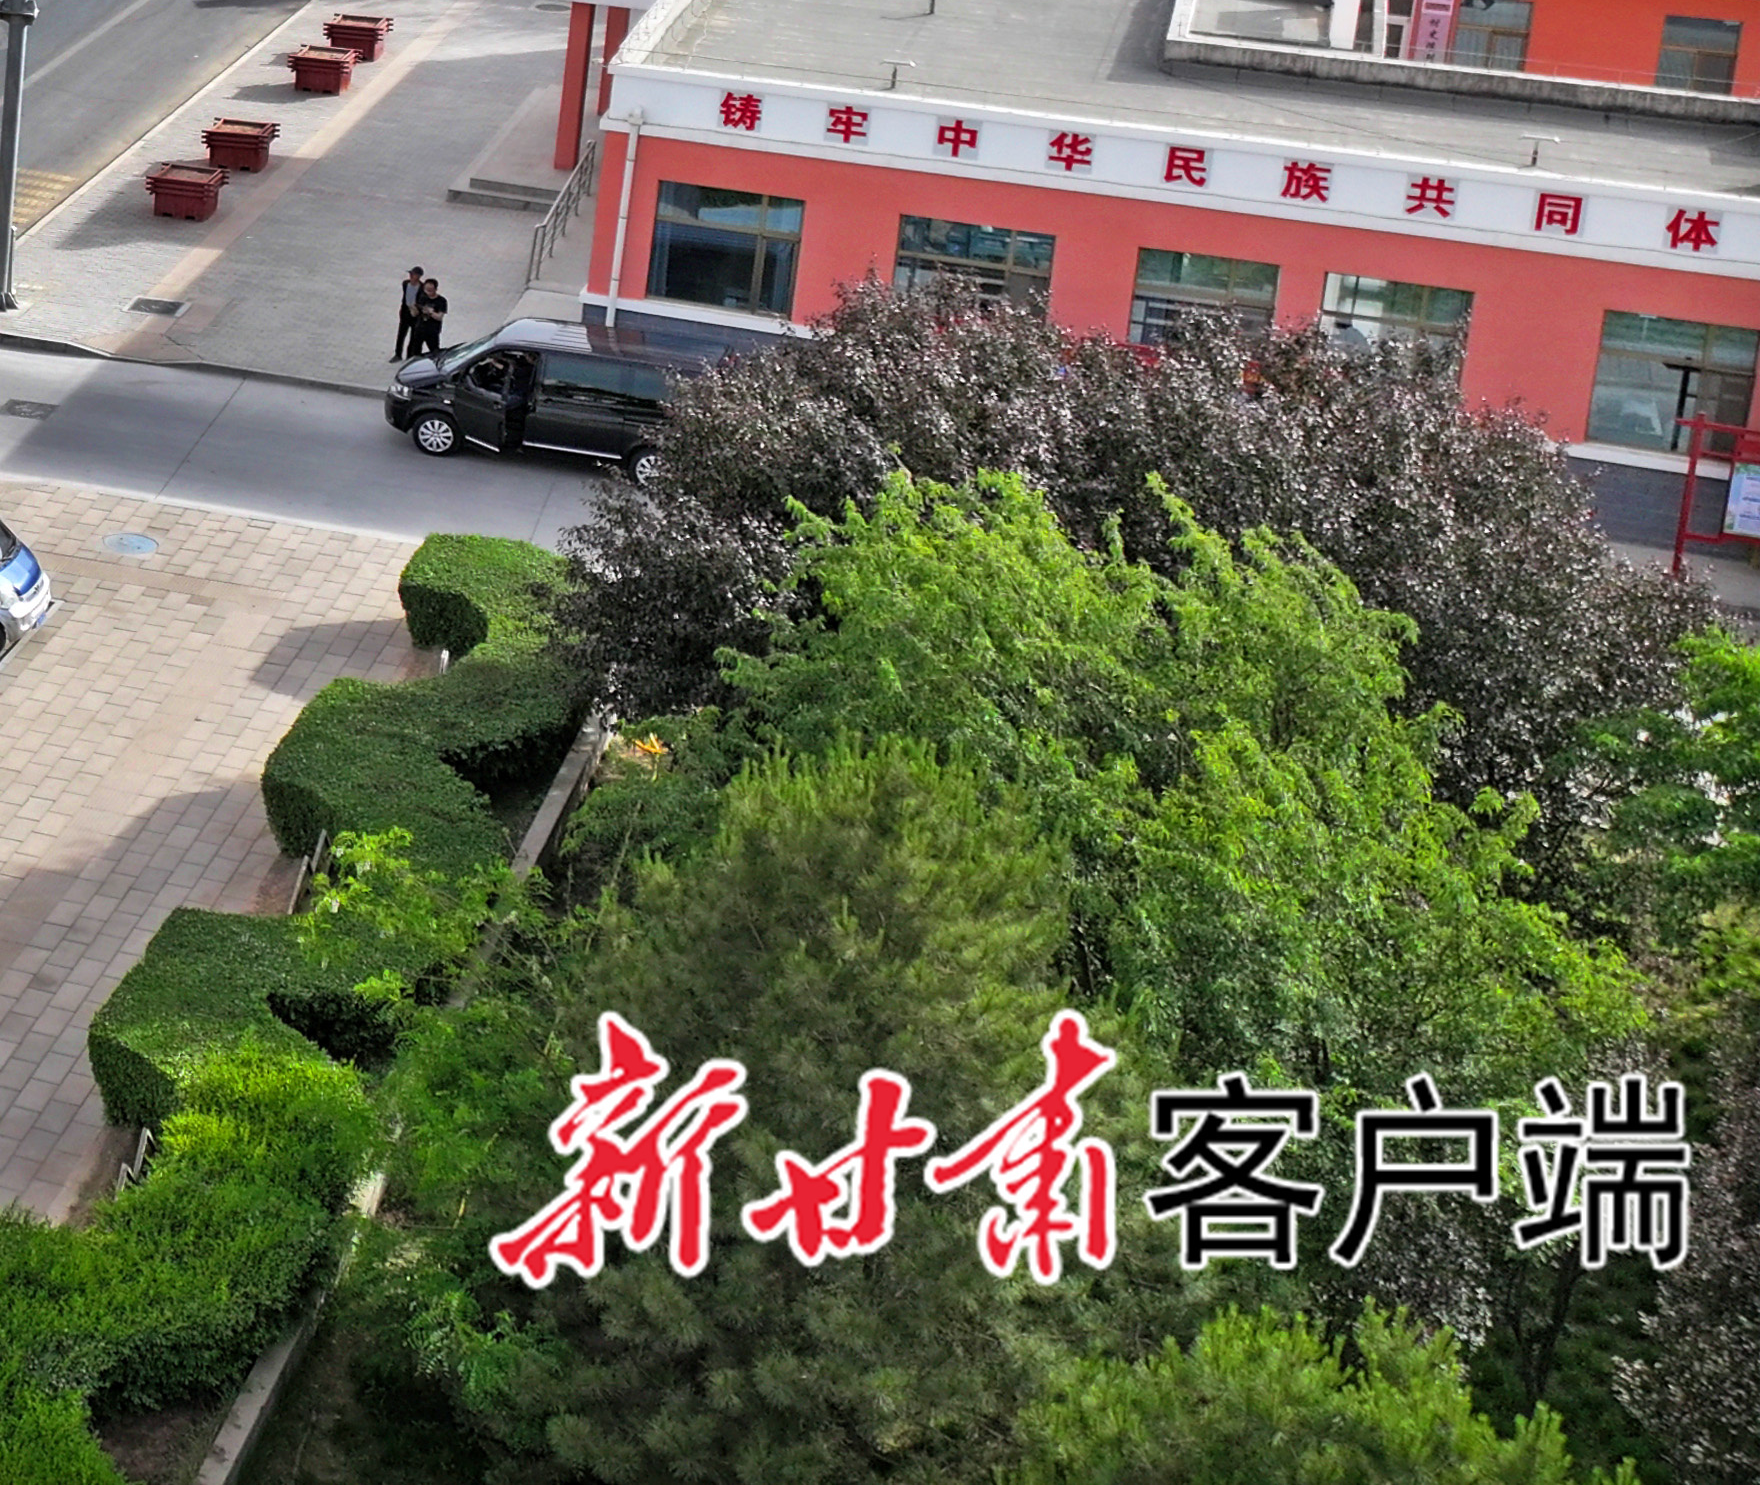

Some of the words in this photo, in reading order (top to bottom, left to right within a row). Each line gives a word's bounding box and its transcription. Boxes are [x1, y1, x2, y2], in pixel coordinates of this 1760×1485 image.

[720, 91, 1720, 252] 铸牢中华民族共同体
